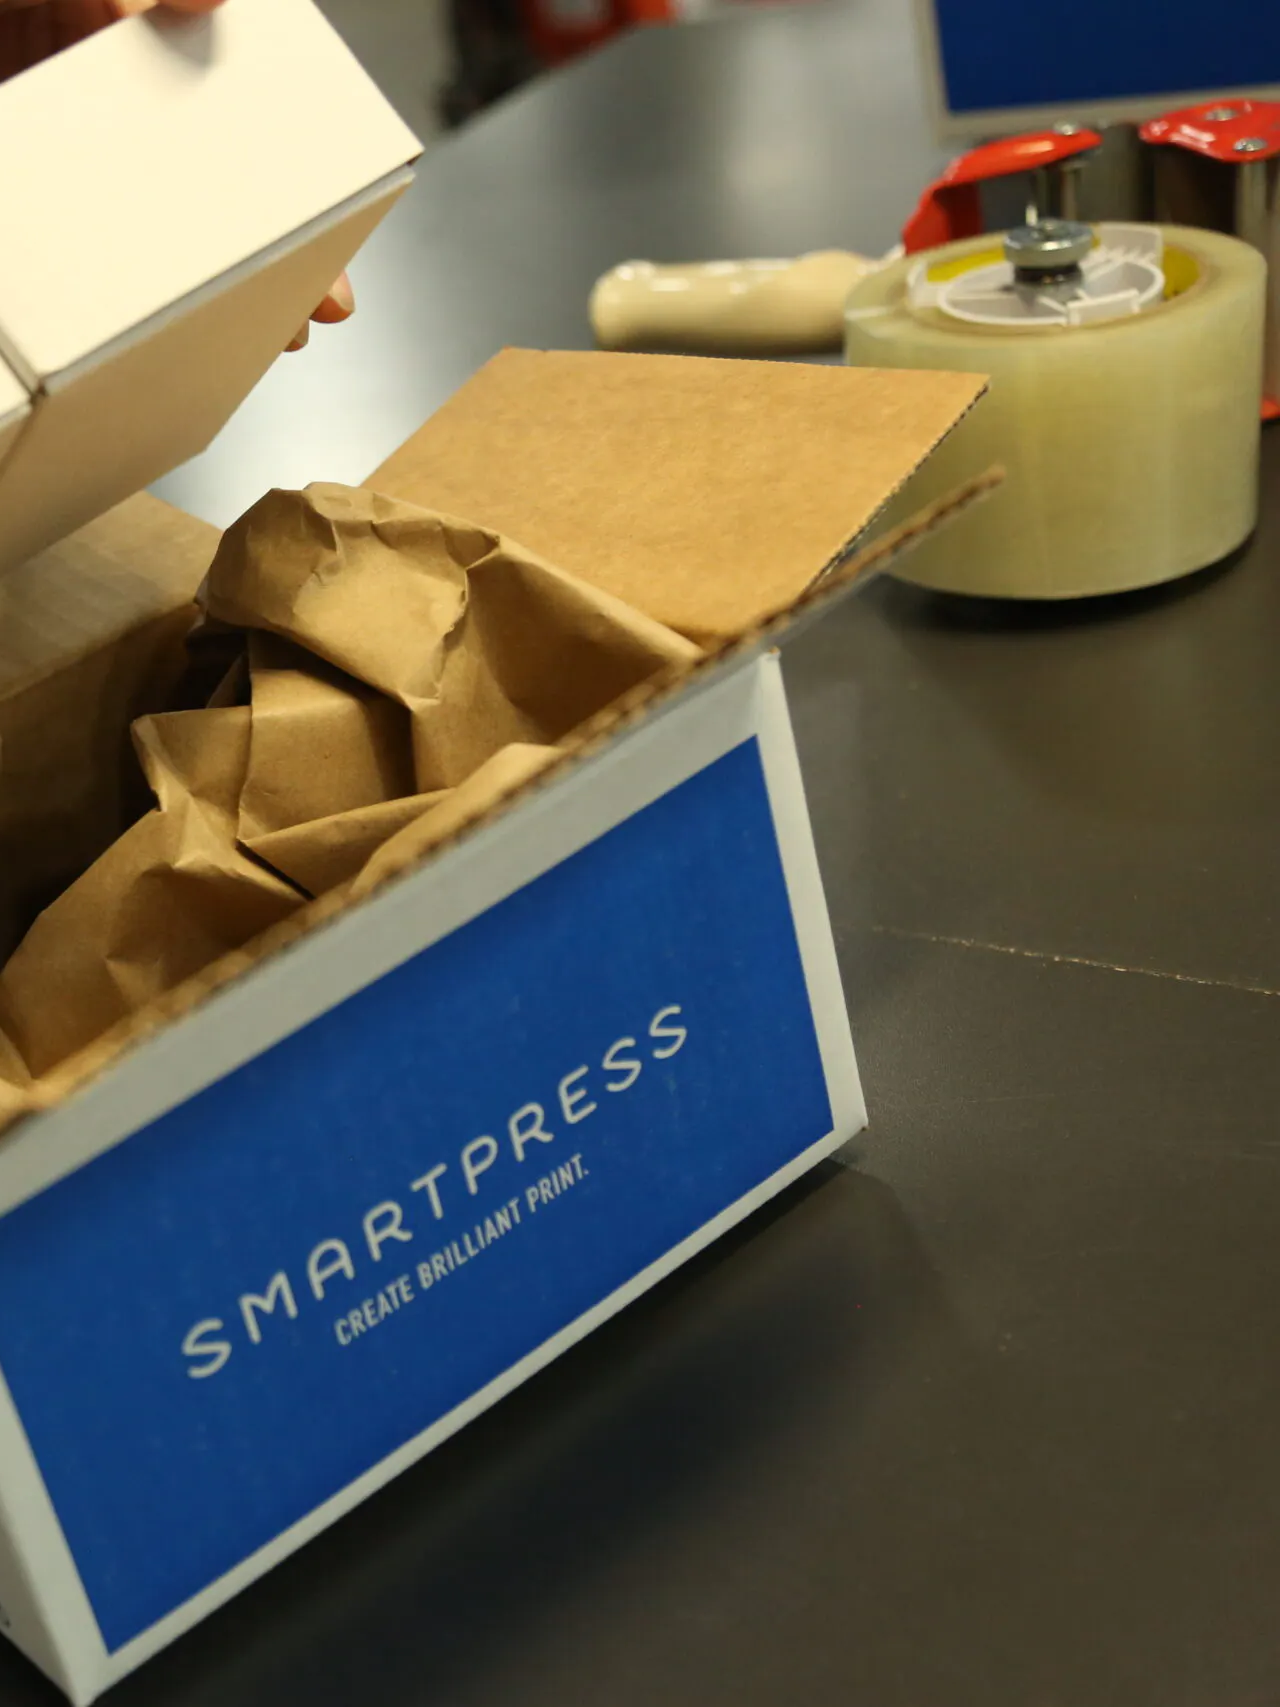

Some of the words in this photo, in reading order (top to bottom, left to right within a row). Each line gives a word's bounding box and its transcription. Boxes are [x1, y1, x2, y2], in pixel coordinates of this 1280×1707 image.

[181, 1004, 688, 1379] SMARTPRESS
[334, 1278, 415, 1346] CREATE
[417, 1199, 522, 1290] BRILLIANT
[525, 1153, 590, 1213] PRINT.
